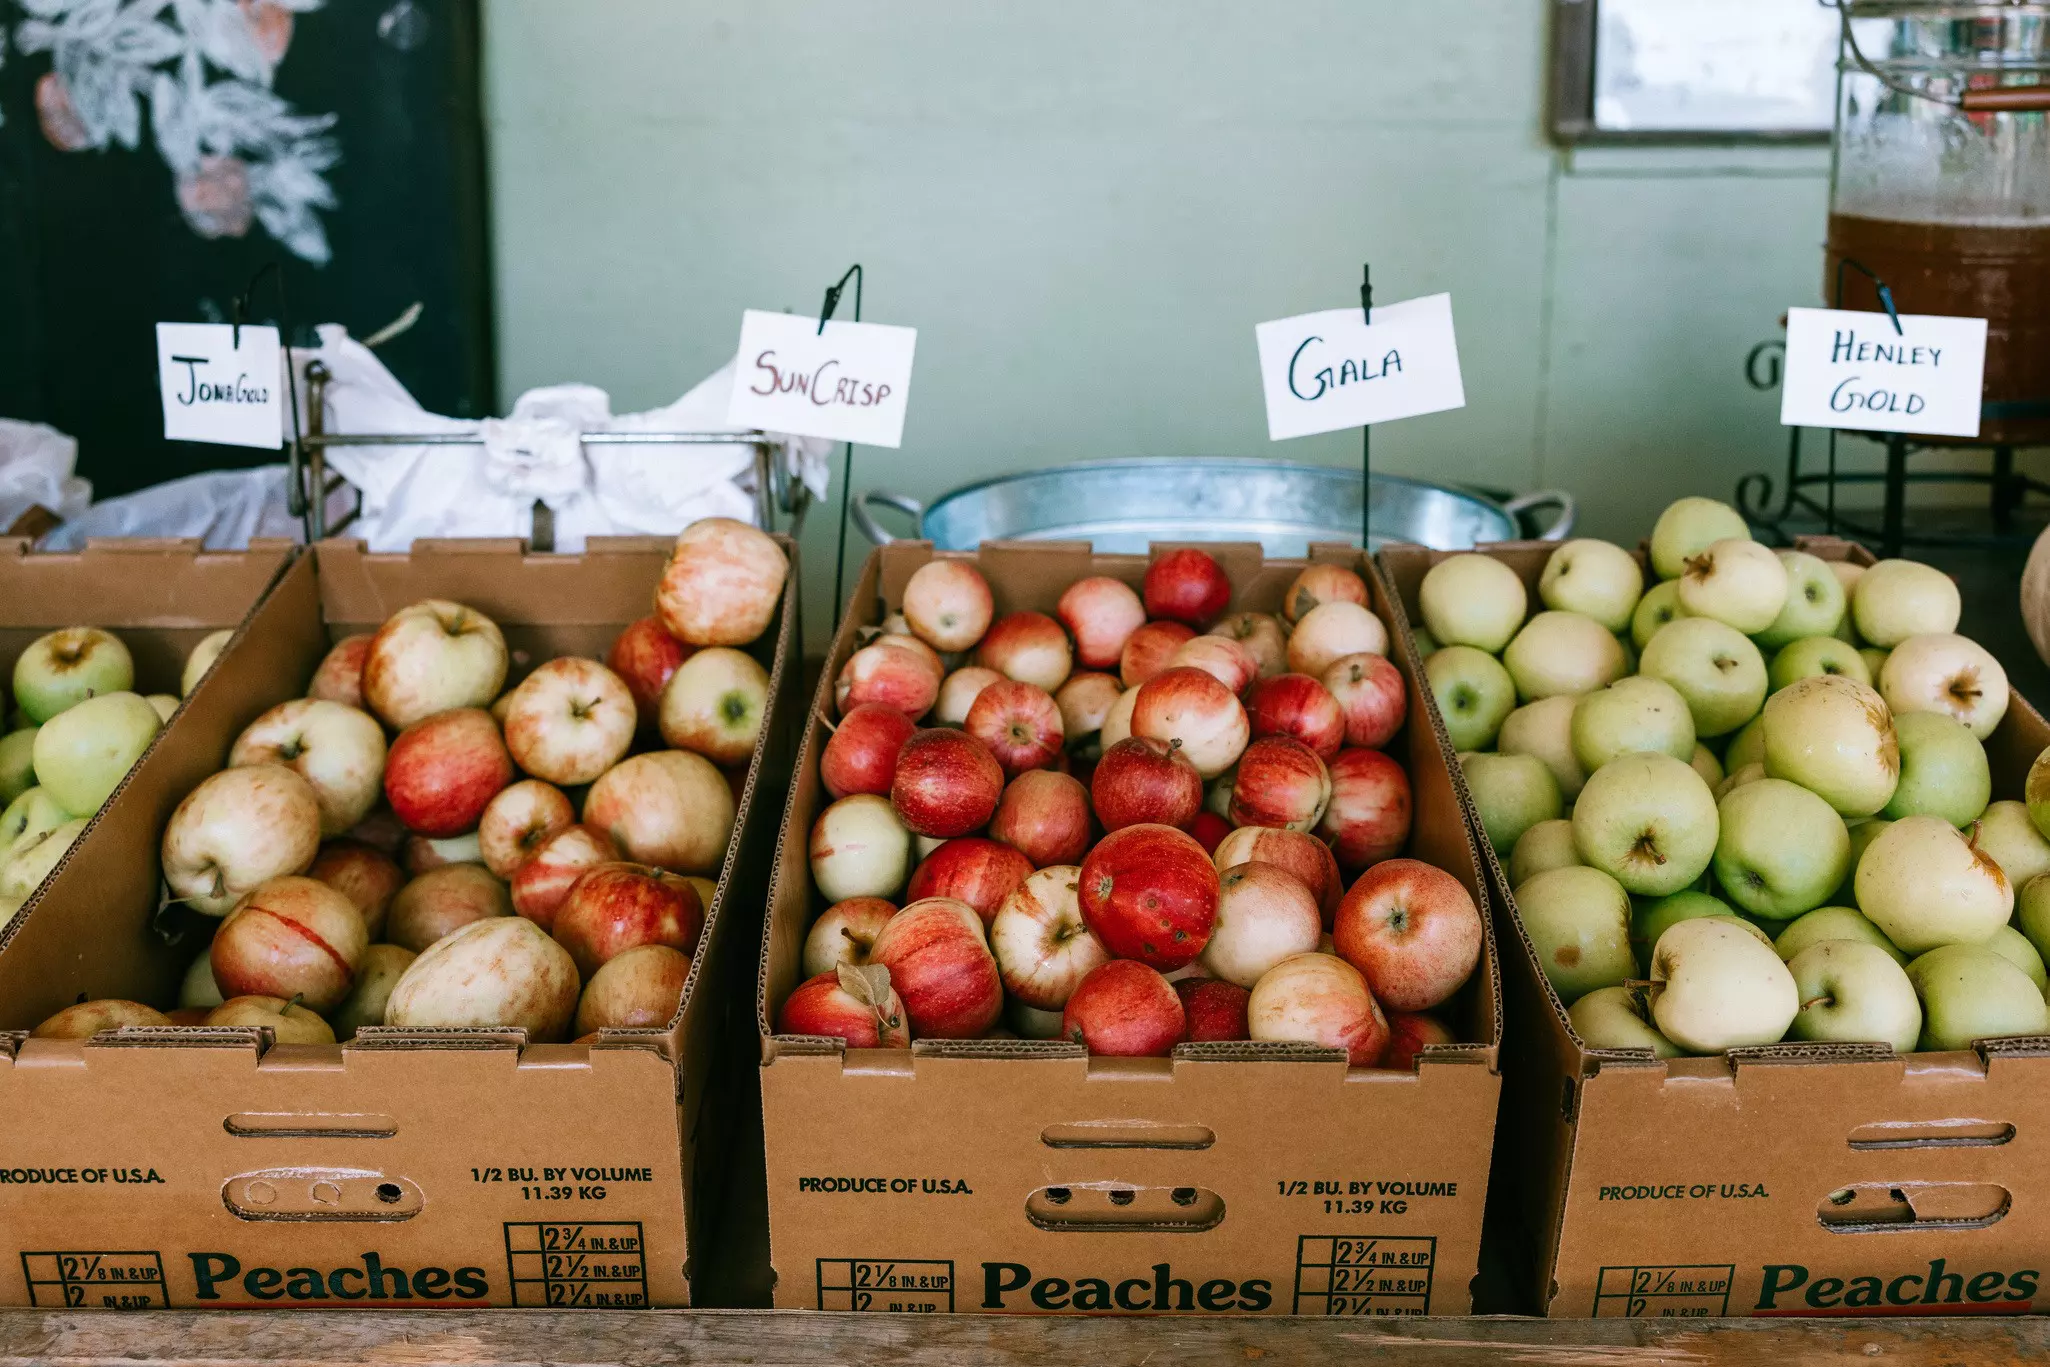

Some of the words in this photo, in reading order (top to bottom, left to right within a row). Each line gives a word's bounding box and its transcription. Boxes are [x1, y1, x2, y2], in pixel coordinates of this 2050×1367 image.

[1832, 330, 1941, 366] HENLEY
[1289, 336, 1401, 400] GALA
[1831, 377, 1925, 414] GOLD
[0, 1168, 78, 1183] RODUCE
[81, 1168, 107, 1183] OF
[113, 1168, 165, 1183] U.S.A.
[471, 1168, 502, 1182] 1/2
[508, 1168, 539, 1182] BU.
[544, 1168, 565, 1181] BY
[571, 1168, 652, 1181] VOLUME
[521, 1186, 572, 1200] 11.39
[579, 1186, 607, 1200] KG
[799, 1177, 886, 1193] PRODUCE
[890, 1178, 917, 1193] OF
[922, 1179, 973, 1194] U.S.A.
[1278, 1181, 1307, 1195] 1/2
[1313, 1181, 1343, 1195] BU.
[1349, 1182, 1372, 1195] BY
[1377, 1182, 1457, 1196] VOLUME
[1599, 1185, 1685, 1200] PRODUCE
[1689, 1184, 1716, 1198] OF
[1720, 1183, 1769, 1198] U.S.A.
[1324, 1200, 1373, 1214] 11.39
[1380, 1200, 1408, 1214] KG
[591, 1238, 607, 1250] IN.
[609, 1238, 619, 1250] &
[620, 1238, 638, 1250] UP
[1382, 1252, 1397, 1264] IN.
[1400, 1253, 1409, 1264] &
[1411, 1253, 1429, 1265] UP
[110, 1268, 127, 1280] IN.
[129, 1268, 139, 1280] &
[140, 1268, 158, 1280] UP
[187, 1252, 489, 1299] Peaches
[594, 1266, 609, 1277] IN.
[611, 1266, 622, 1277] &
[623, 1266, 640, 1277] UP
[902, 1276, 918, 1288] IN.
[920, 1276, 929, 1288] &
[931, 1276, 948, 1288] UP
[981, 1262, 1272, 1311] Peaches
[1379, 1280, 1394, 1292] IN.
[1397, 1280, 1406, 1292] &
[1408, 1280, 1426, 1292] UP
[1680, 1281, 1694, 1292] IN.
[1697, 1281, 1706, 1292] &
[1709, 1281, 1726, 1292] UP
[1754, 1258, 2040, 1309] Peaches
[69, 1286, 87, 1307] 2
[133, 1296, 151, 1307] UP
[614, 1294, 625, 1305] &
[626, 1294, 643, 1305] UP
[858, 1292, 872, 1312] 2
[890, 1303, 902, 1312] IN
[1633, 1298, 1647, 1317] 2
[1663, 1308, 1675, 1317] IN
